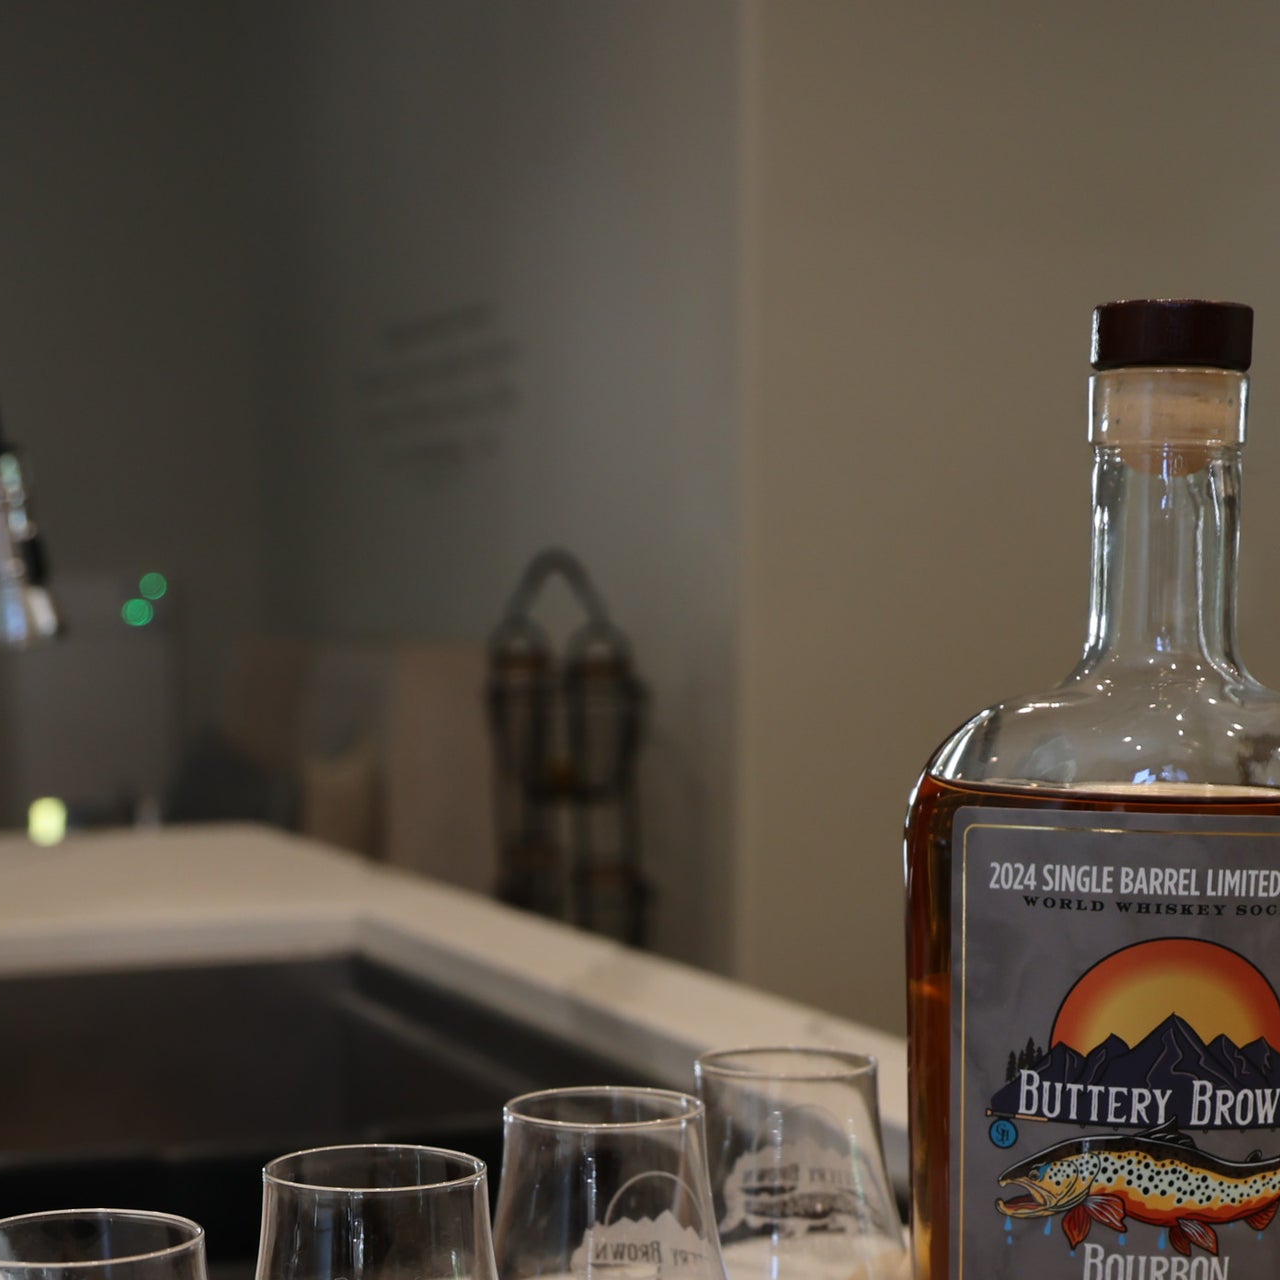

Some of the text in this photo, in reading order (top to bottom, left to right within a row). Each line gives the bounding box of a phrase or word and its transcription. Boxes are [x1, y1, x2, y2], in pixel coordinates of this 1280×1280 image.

[989, 861, 1037, 890] 2024
[1042, 863, 1115, 893] SINGLE
[1120, 866, 1200, 896] BARREL
[1022, 895, 1105, 912] WORLD
[1116, 901, 1227, 915] WHISKEY
[1018, 1069, 1172, 1125] BUTTERY
